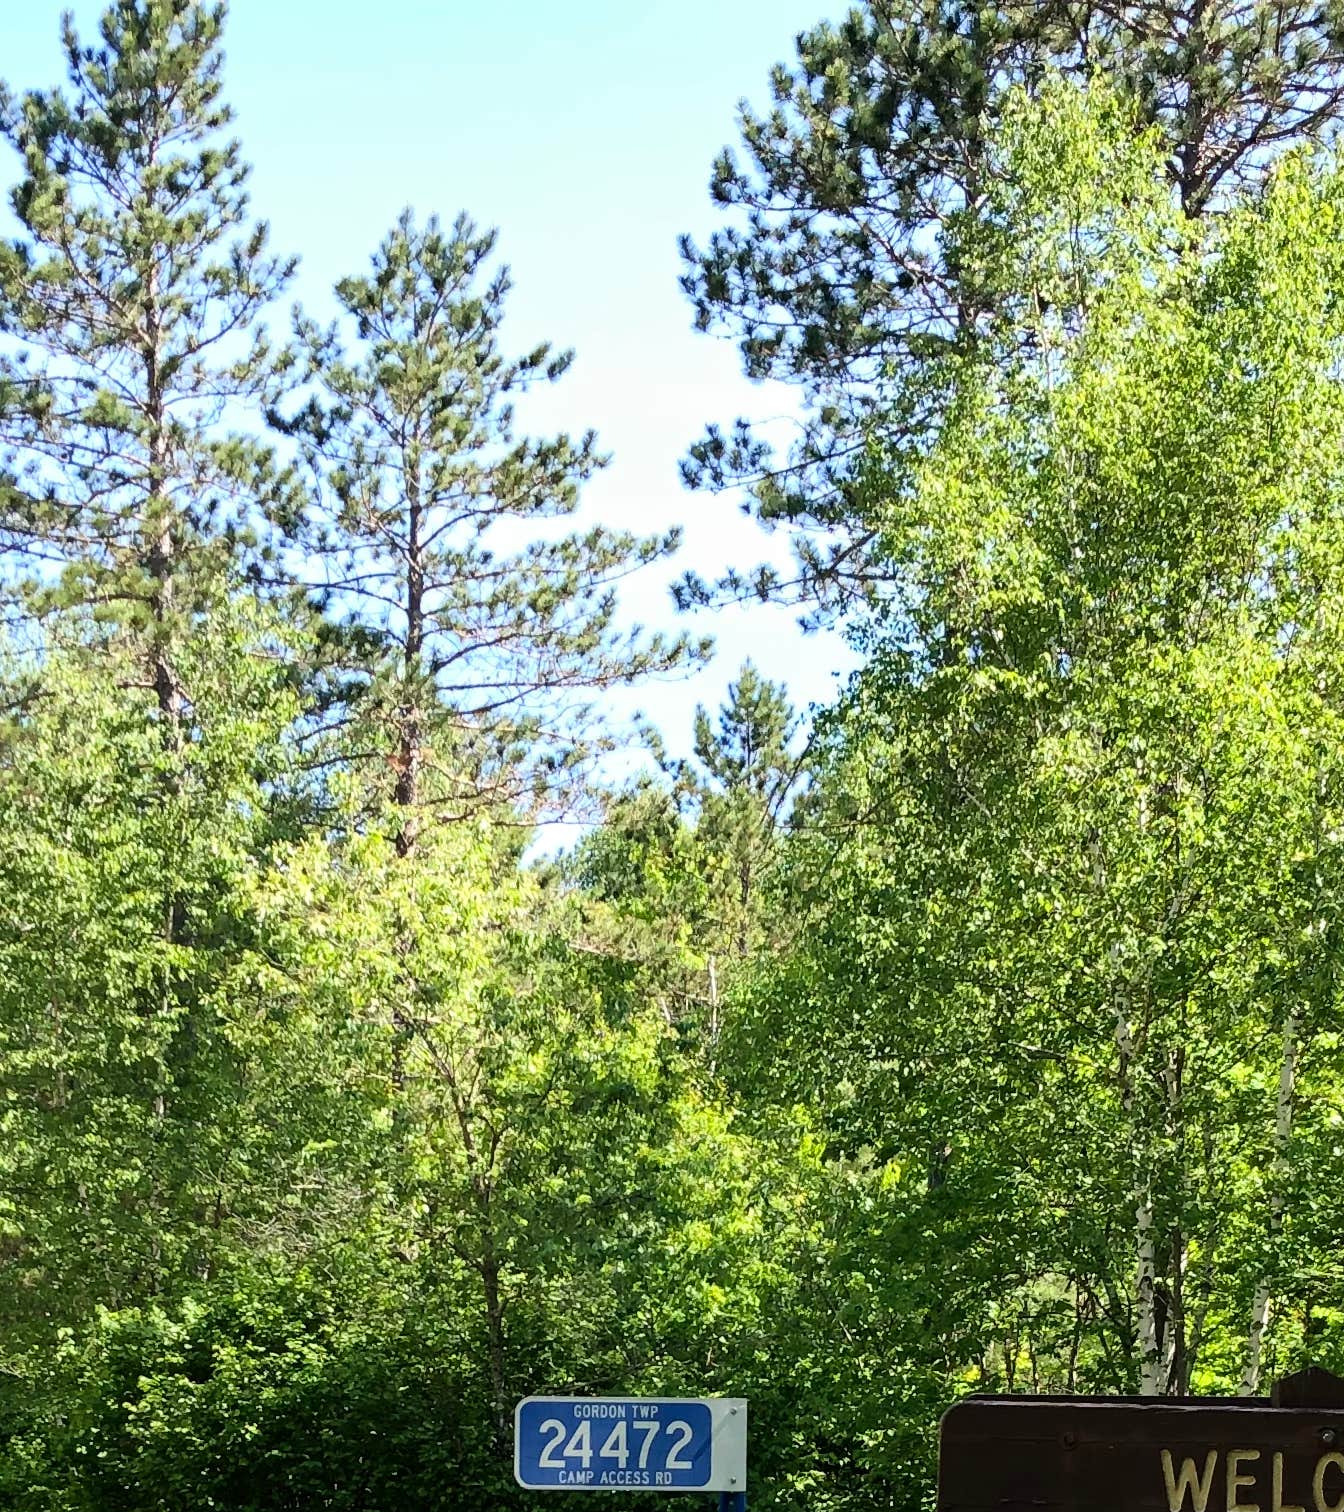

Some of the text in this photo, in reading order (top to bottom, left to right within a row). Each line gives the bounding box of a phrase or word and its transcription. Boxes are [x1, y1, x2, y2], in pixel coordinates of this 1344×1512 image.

[573, 1404, 658, 1419] GORDON TWP
[538, 1419, 693, 1470] 24472
[558, 1470, 672, 1485] CAMP ACCESS RD
